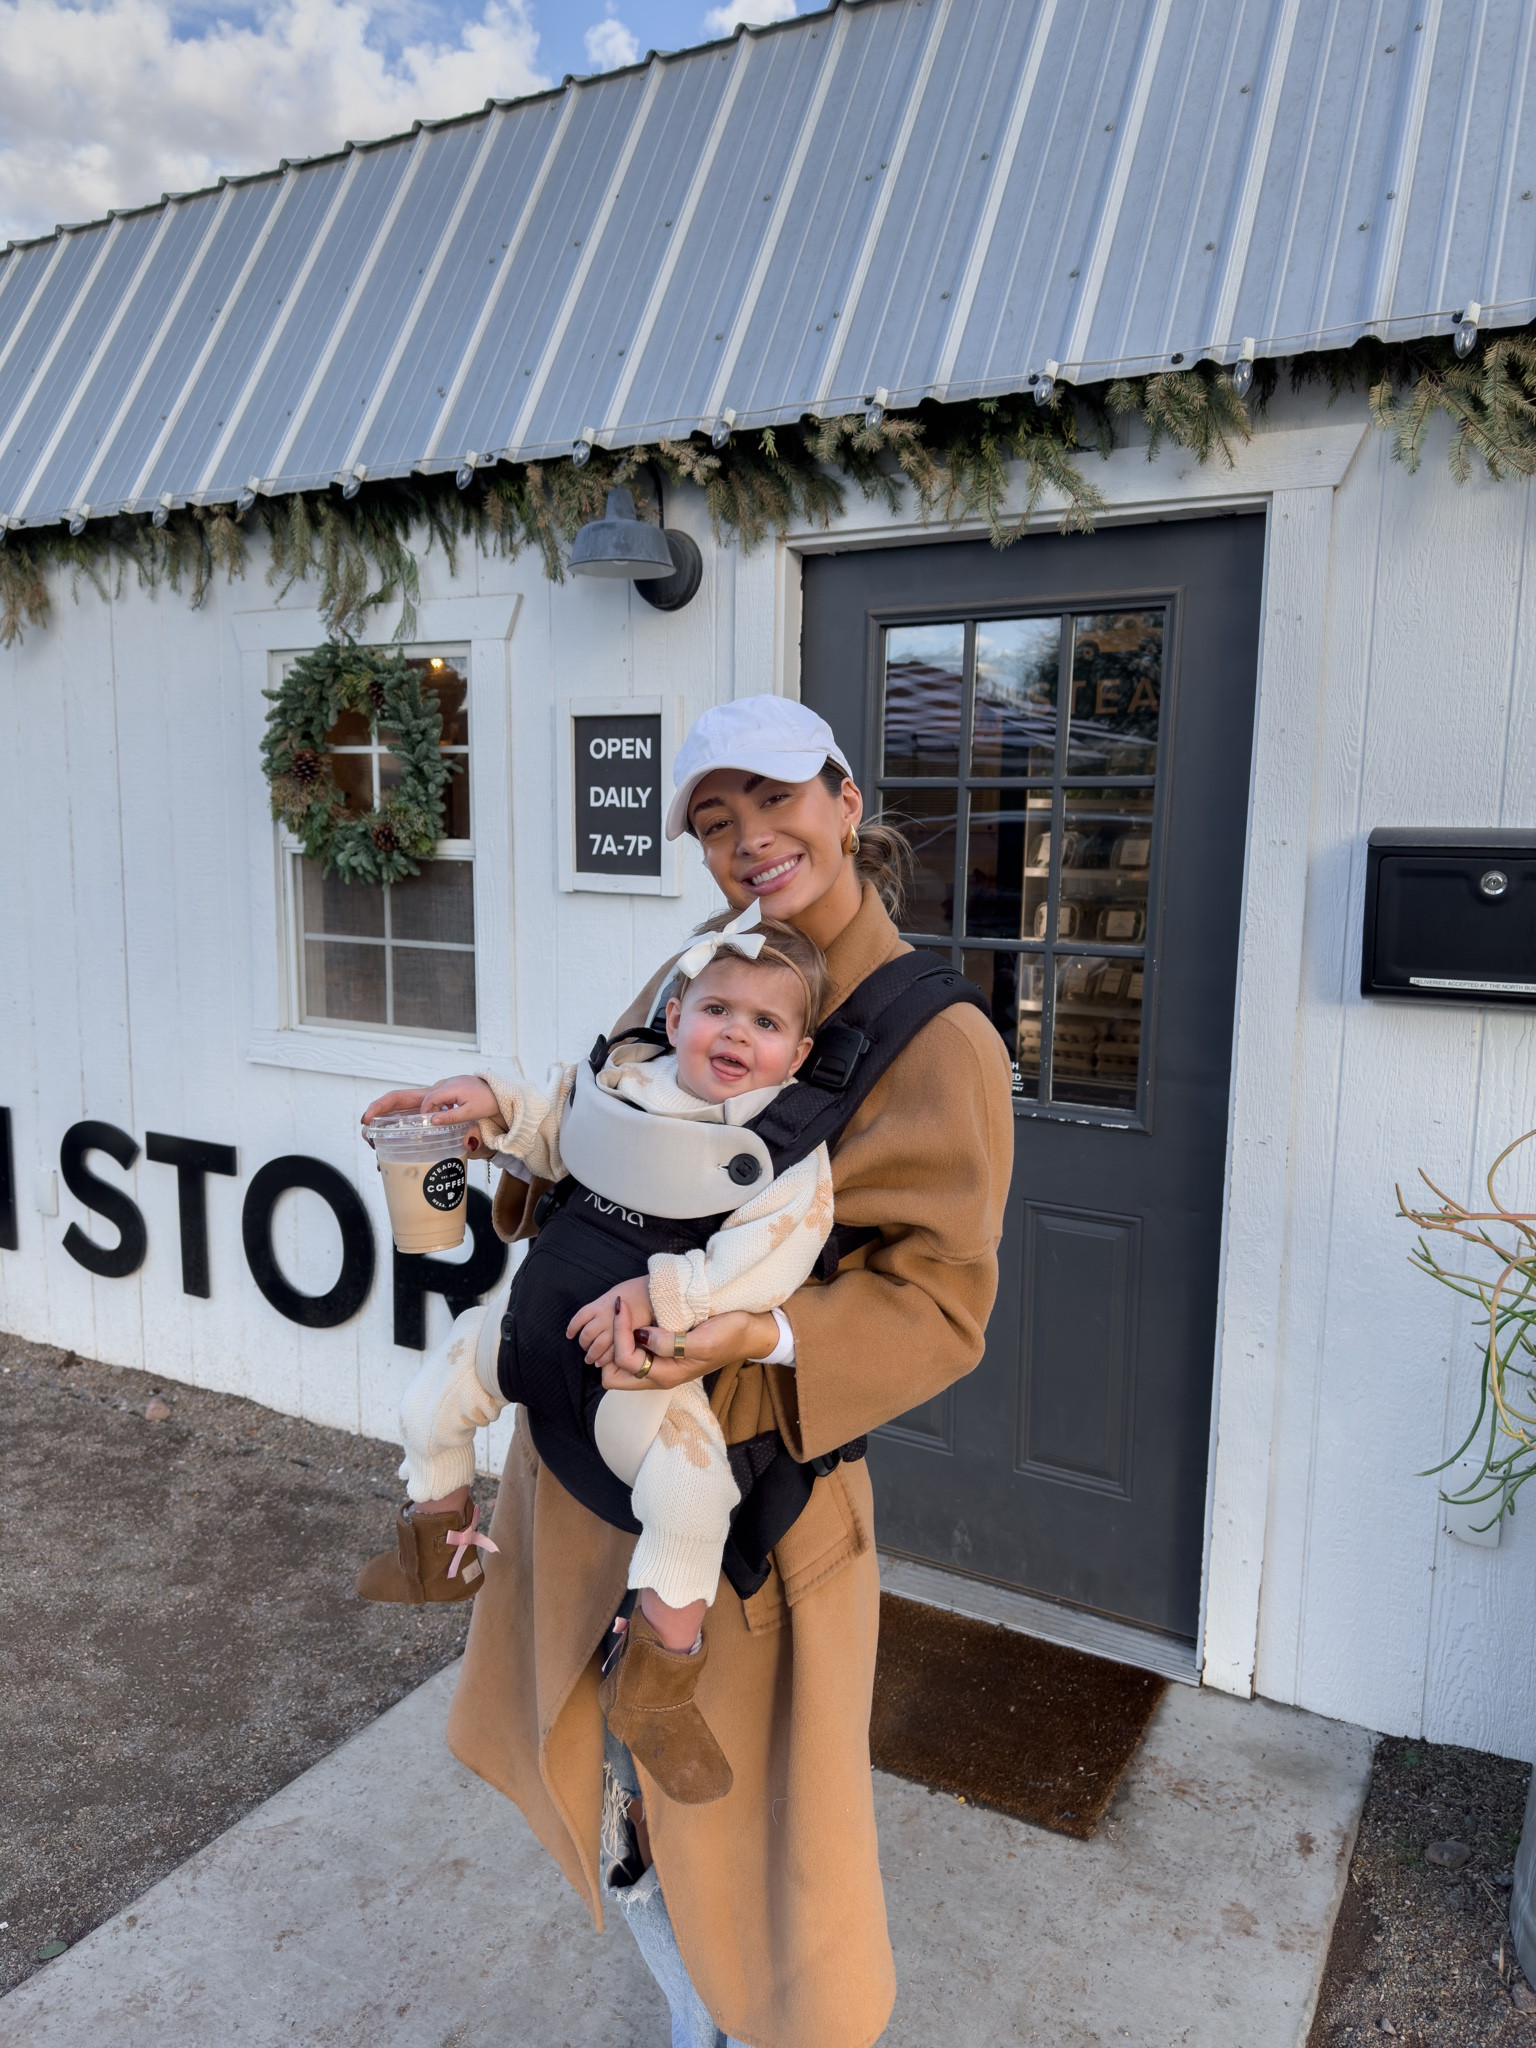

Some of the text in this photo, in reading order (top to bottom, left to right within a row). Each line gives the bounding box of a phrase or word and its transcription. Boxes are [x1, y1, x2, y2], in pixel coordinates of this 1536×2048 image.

[589, 737, 651, 760] OPEN
[589, 786, 652, 808] DAILY
[589, 834, 652, 856] 7A-7P
[1413, 978, 1447, 987] DELIVERIES
[1447, 980, 1480, 988] ACCEPTED
[429, 1162, 464, 1181] STEADFAST
[427, 1176, 465, 1193] COFFEE
[584, 1192, 644, 1228] nuna
[60, 1119, 537, 1350] STOR
